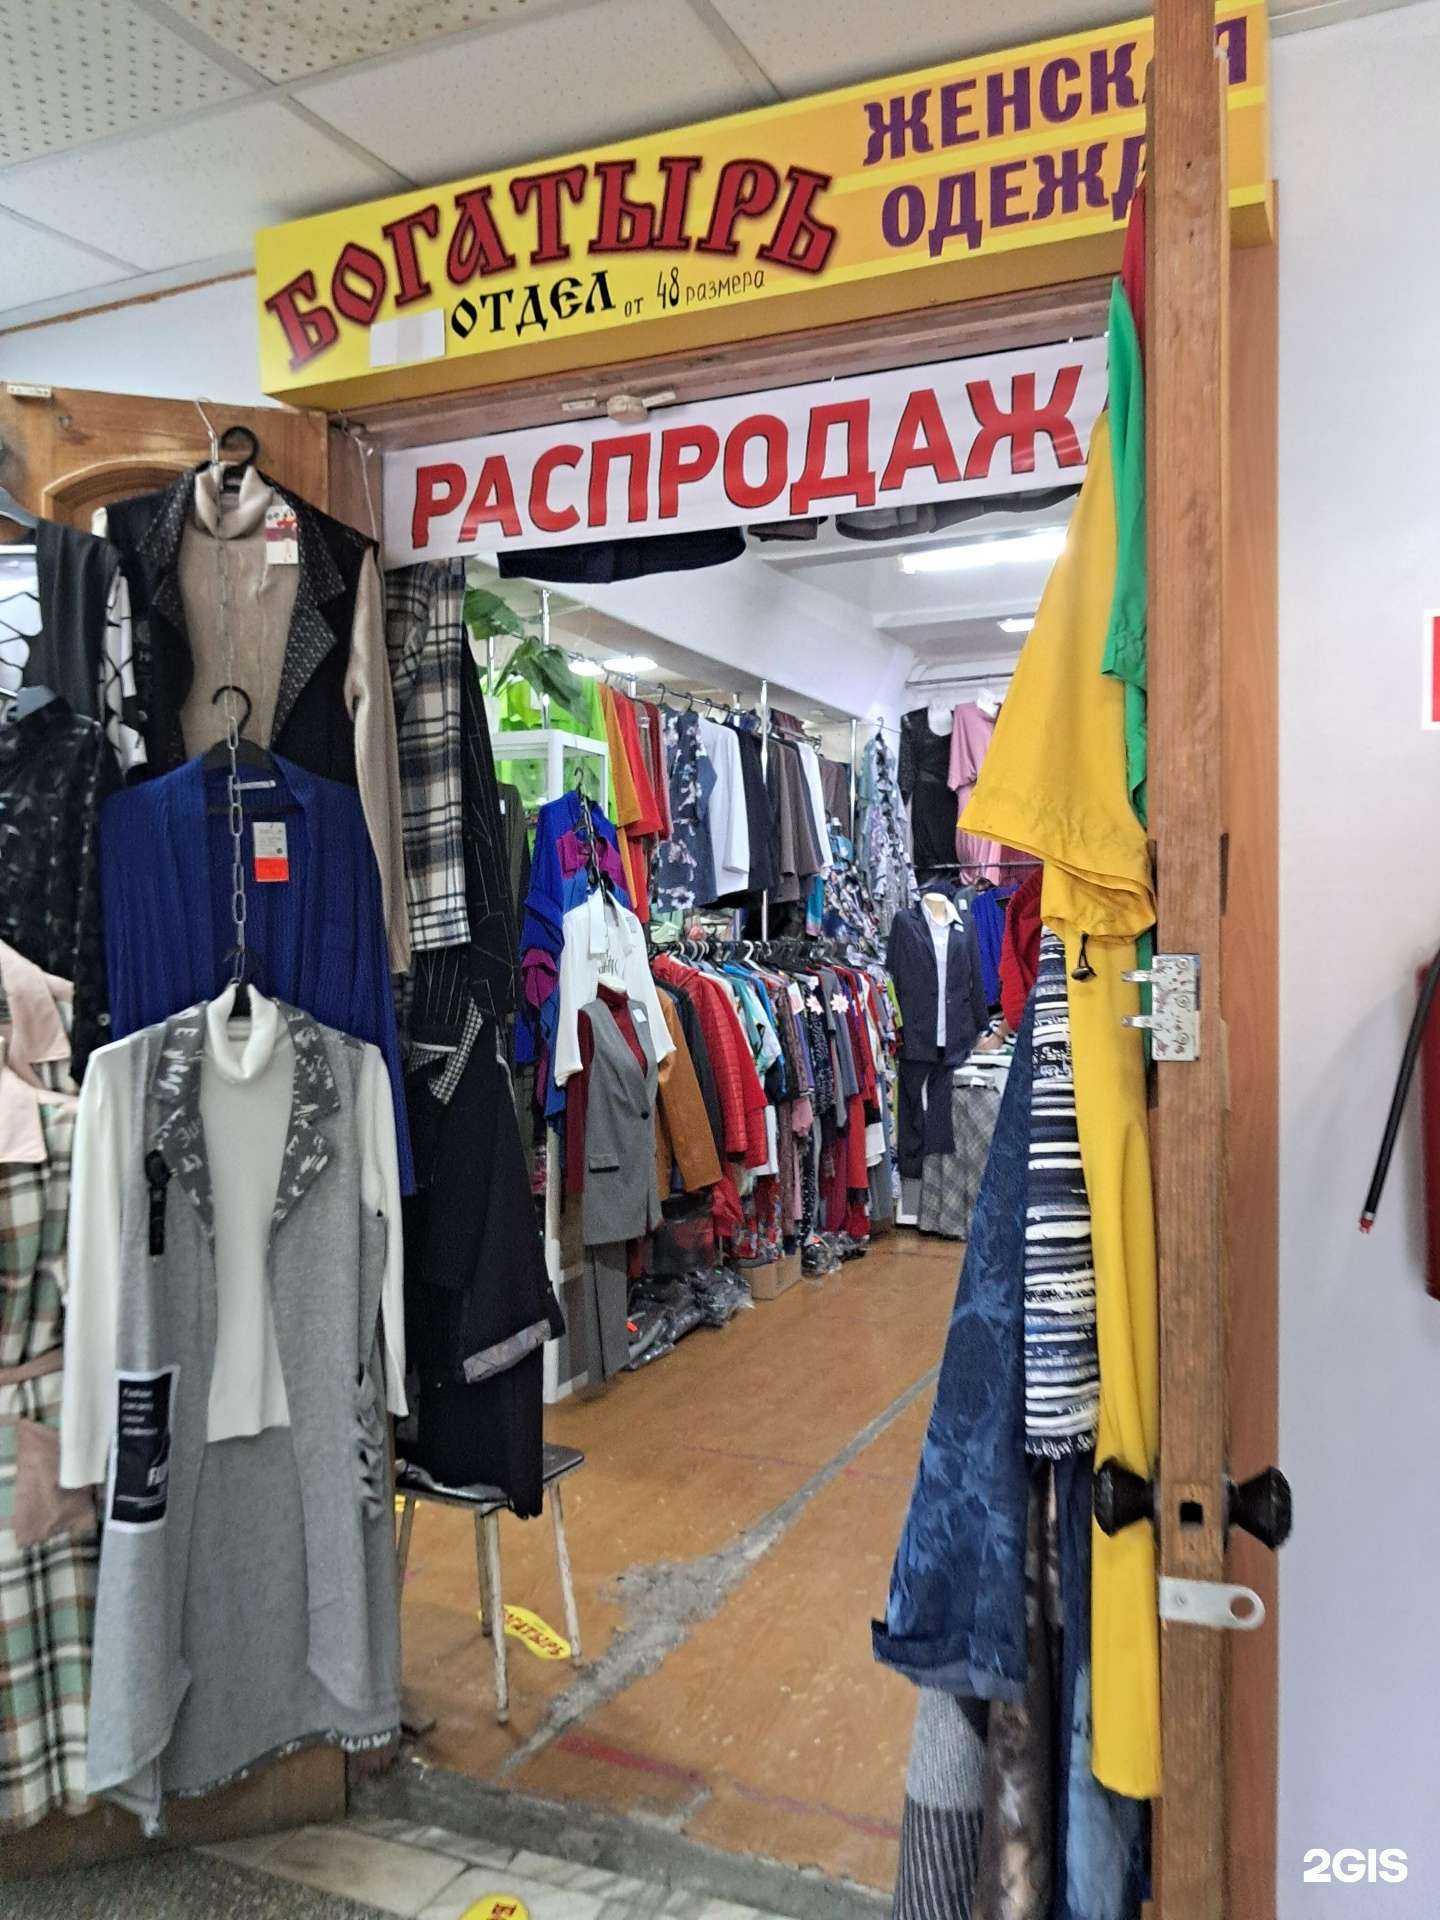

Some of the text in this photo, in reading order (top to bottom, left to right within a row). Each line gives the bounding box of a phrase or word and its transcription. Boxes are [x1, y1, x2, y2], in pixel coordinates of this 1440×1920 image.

[863, 16, 1247, 167] ЖЕНСКЯ
[265, 156, 837, 369] БОГАТЫРЬ
[881, 136, 1147, 257] ОДЕЖД
[450, 266, 765, 339] ОТДЕЛ от 48 размера
[411, 364, 1106, 549] РАСПРОДАЖ
